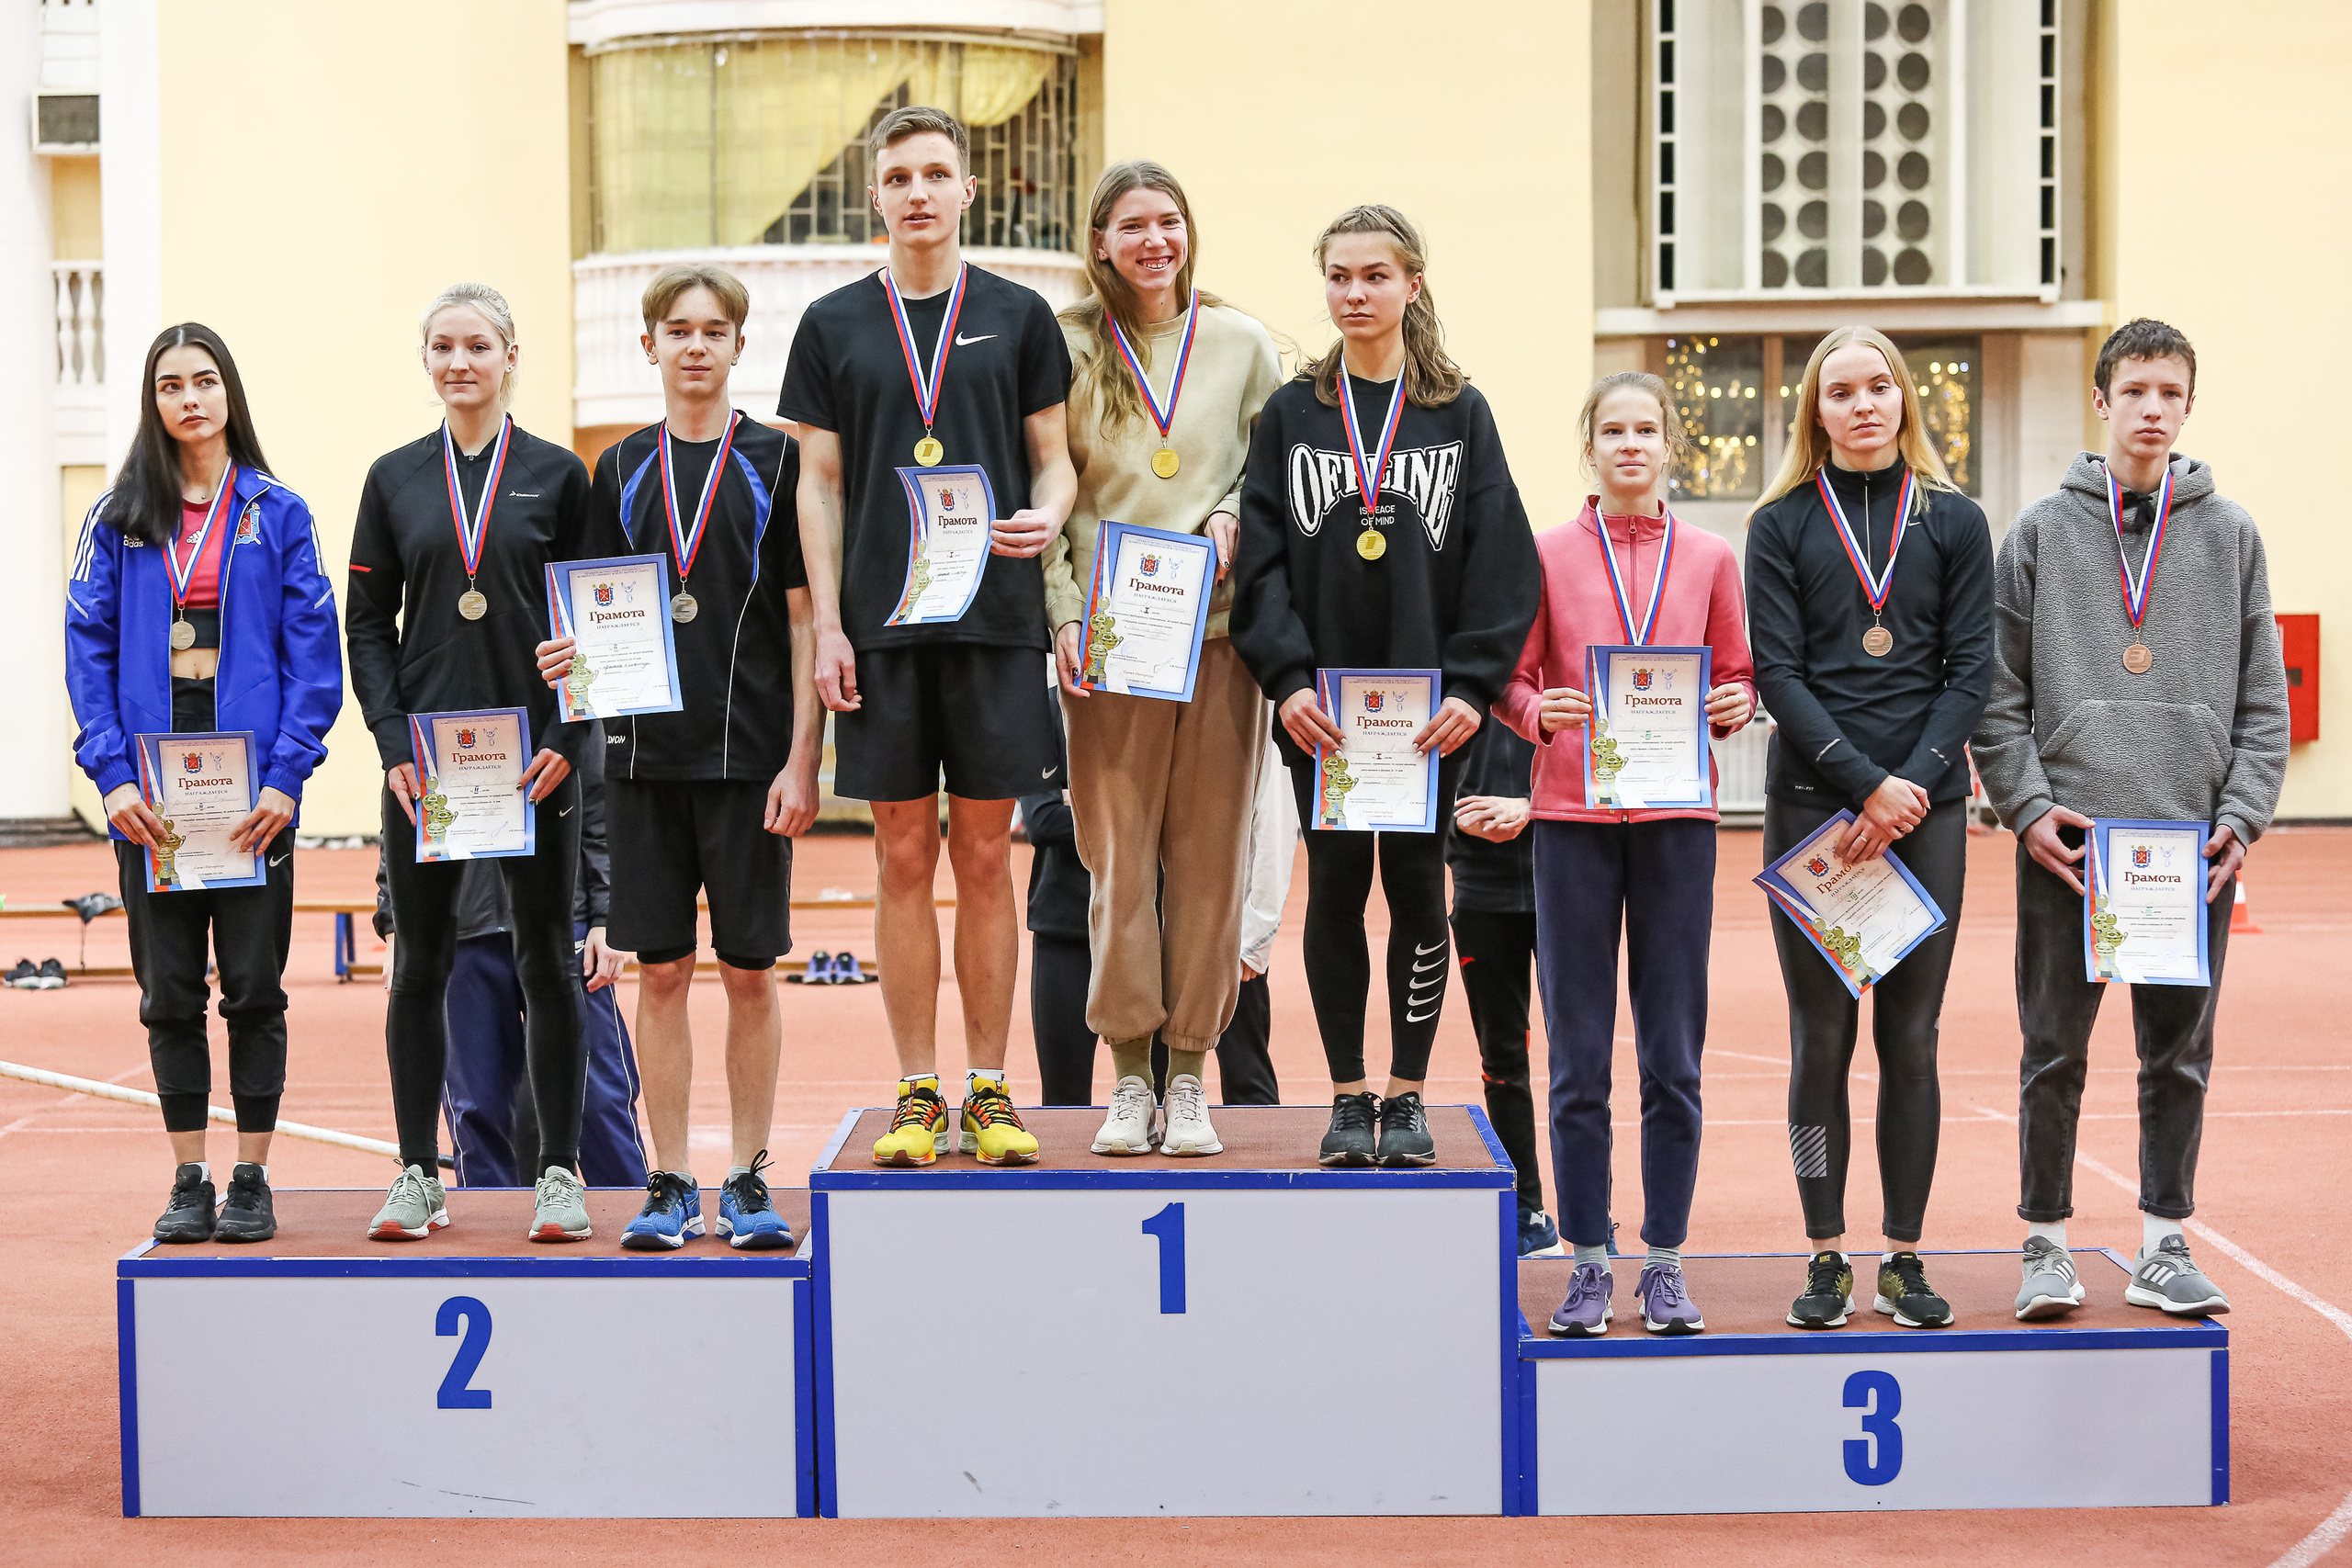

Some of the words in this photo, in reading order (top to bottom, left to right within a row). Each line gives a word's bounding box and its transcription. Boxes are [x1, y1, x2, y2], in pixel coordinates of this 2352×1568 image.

[1290, 440, 1463, 551] OFINE
[1360, 506, 1369, 514] IS
[1374, 504, 1396, 514] EACE
[937, 515, 978, 528] Грамота
[1374, 516, 1395, 525] MIND
[123, 538, 144, 548] adas
[1128, 578, 1184, 596] Грамота
[589, 609, 646, 625] Грамота
[1624, 694, 1683, 707] Грамота
[1356, 716, 1414, 729] Грамота
[452, 752, 507, 765] Грамота
[177, 777, 233, 790] Грамота
[1815, 863, 1852, 896] Грамо
[2124, 872, 2182, 885] Грамота
[1141, 1201, 1186, 1314] 1
[435, 1295, 492, 1409] 2
[1841, 1370, 1904, 1486] 3
